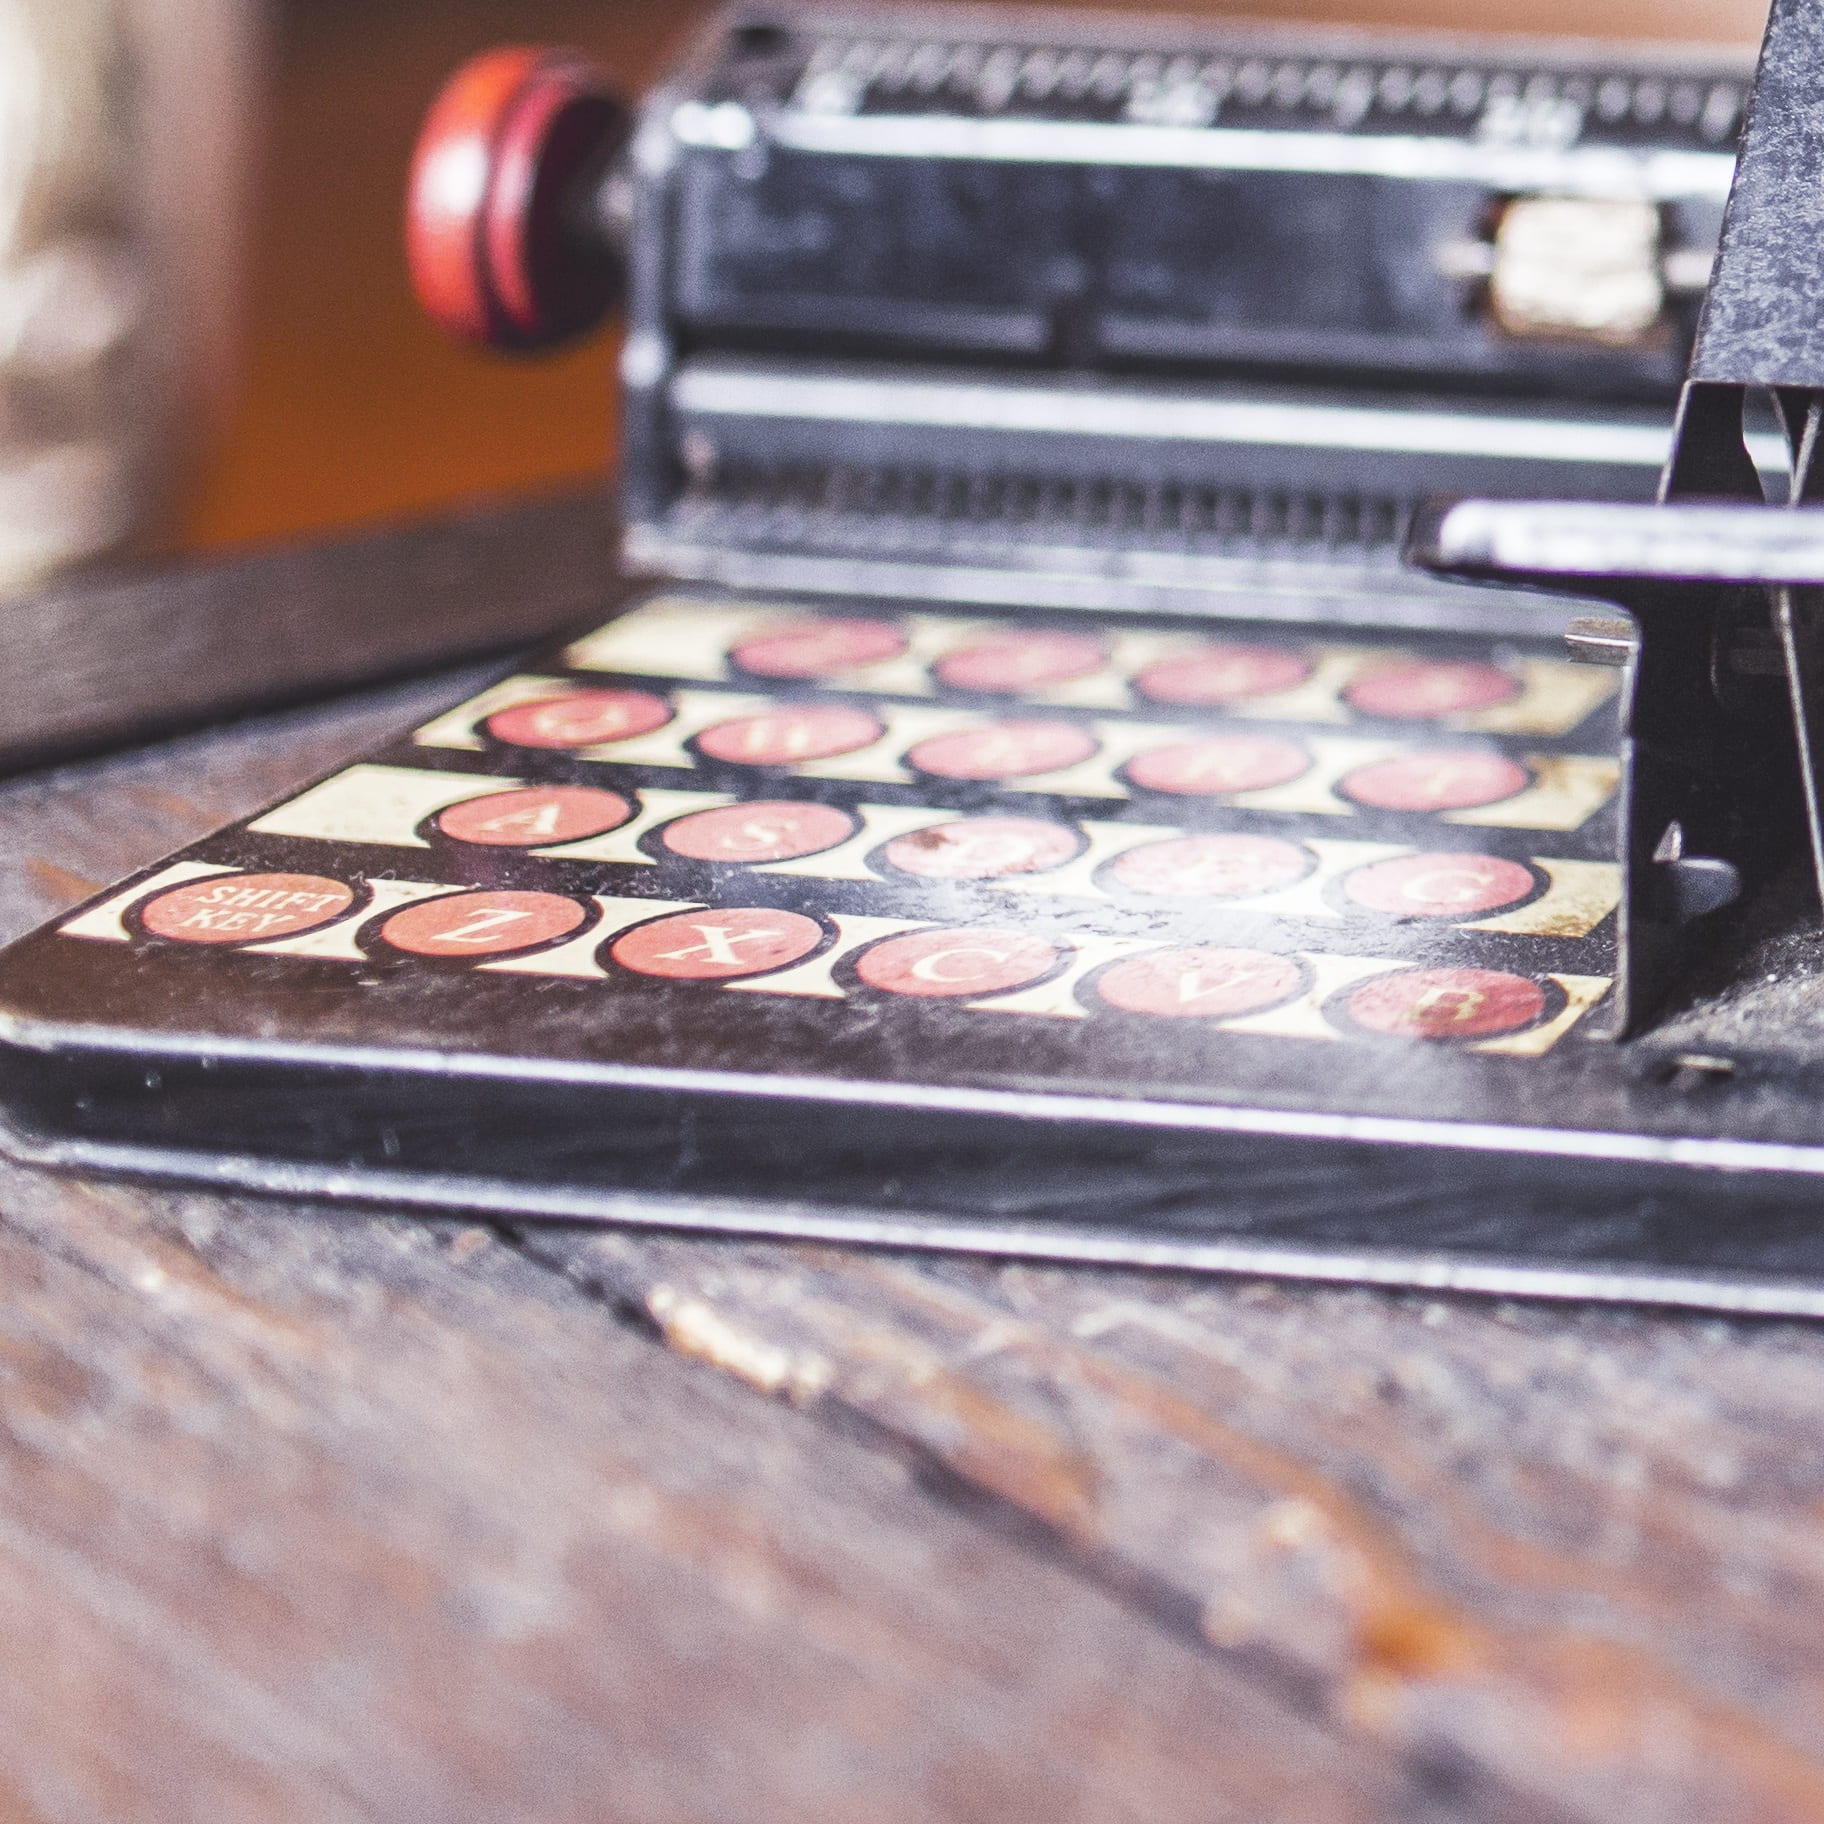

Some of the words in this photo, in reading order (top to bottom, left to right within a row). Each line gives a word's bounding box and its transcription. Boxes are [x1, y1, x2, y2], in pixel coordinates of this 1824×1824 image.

[477, 803, 563, 836] A
[722, 817, 799, 852] S
[197, 884, 349, 914] SHIFT
[180, 908, 298, 934] KEY
[429, 907, 535, 945] Z
[649, 923, 786, 965] X
[910, 947, 1010, 982] C
[1178, 966, 1258, 1004] V
